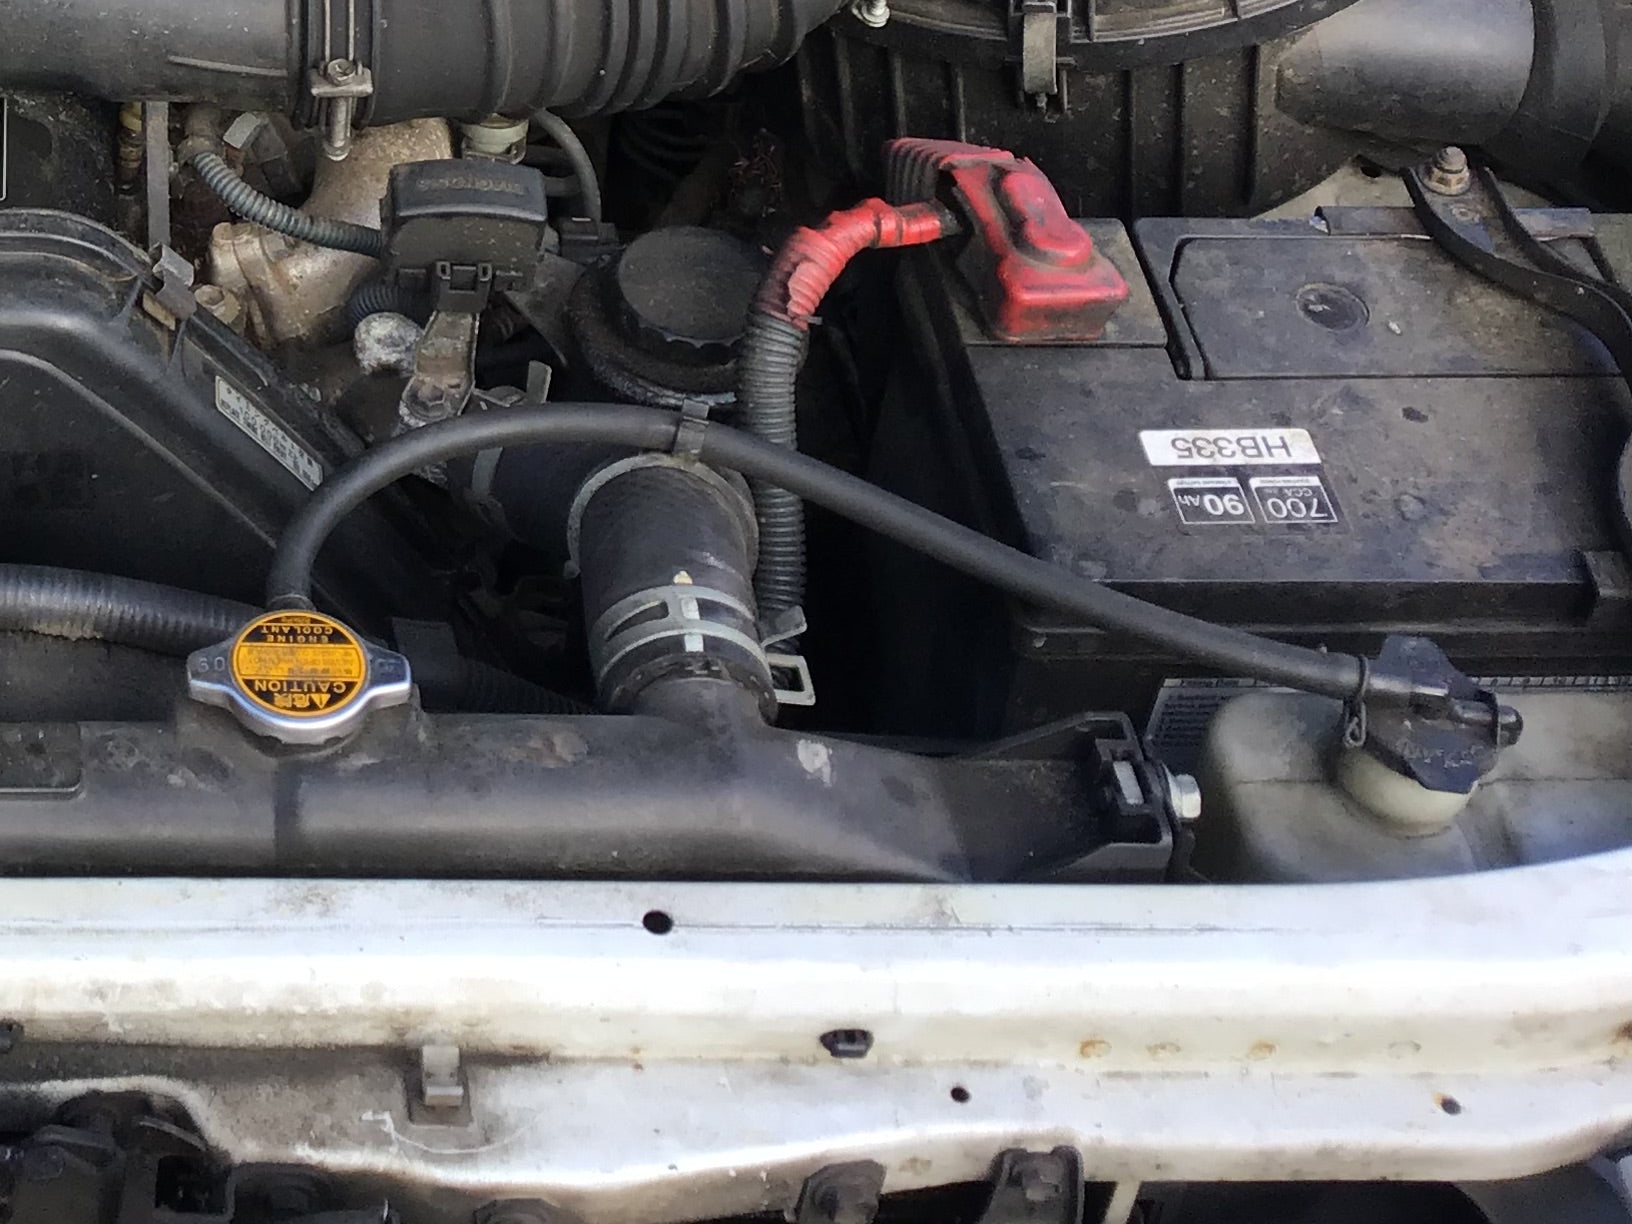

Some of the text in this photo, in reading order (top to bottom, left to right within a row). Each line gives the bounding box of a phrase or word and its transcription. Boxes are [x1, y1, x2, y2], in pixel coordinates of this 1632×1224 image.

[1171, 436, 1293, 458] HB335
[1284, 487, 1313, 497] CCA
[1267, 498, 1328, 518] 700
[260, 625, 334, 634] COOLANT
[266, 634, 329, 643] ENGINE
[254, 679, 347, 693] CAUTION
